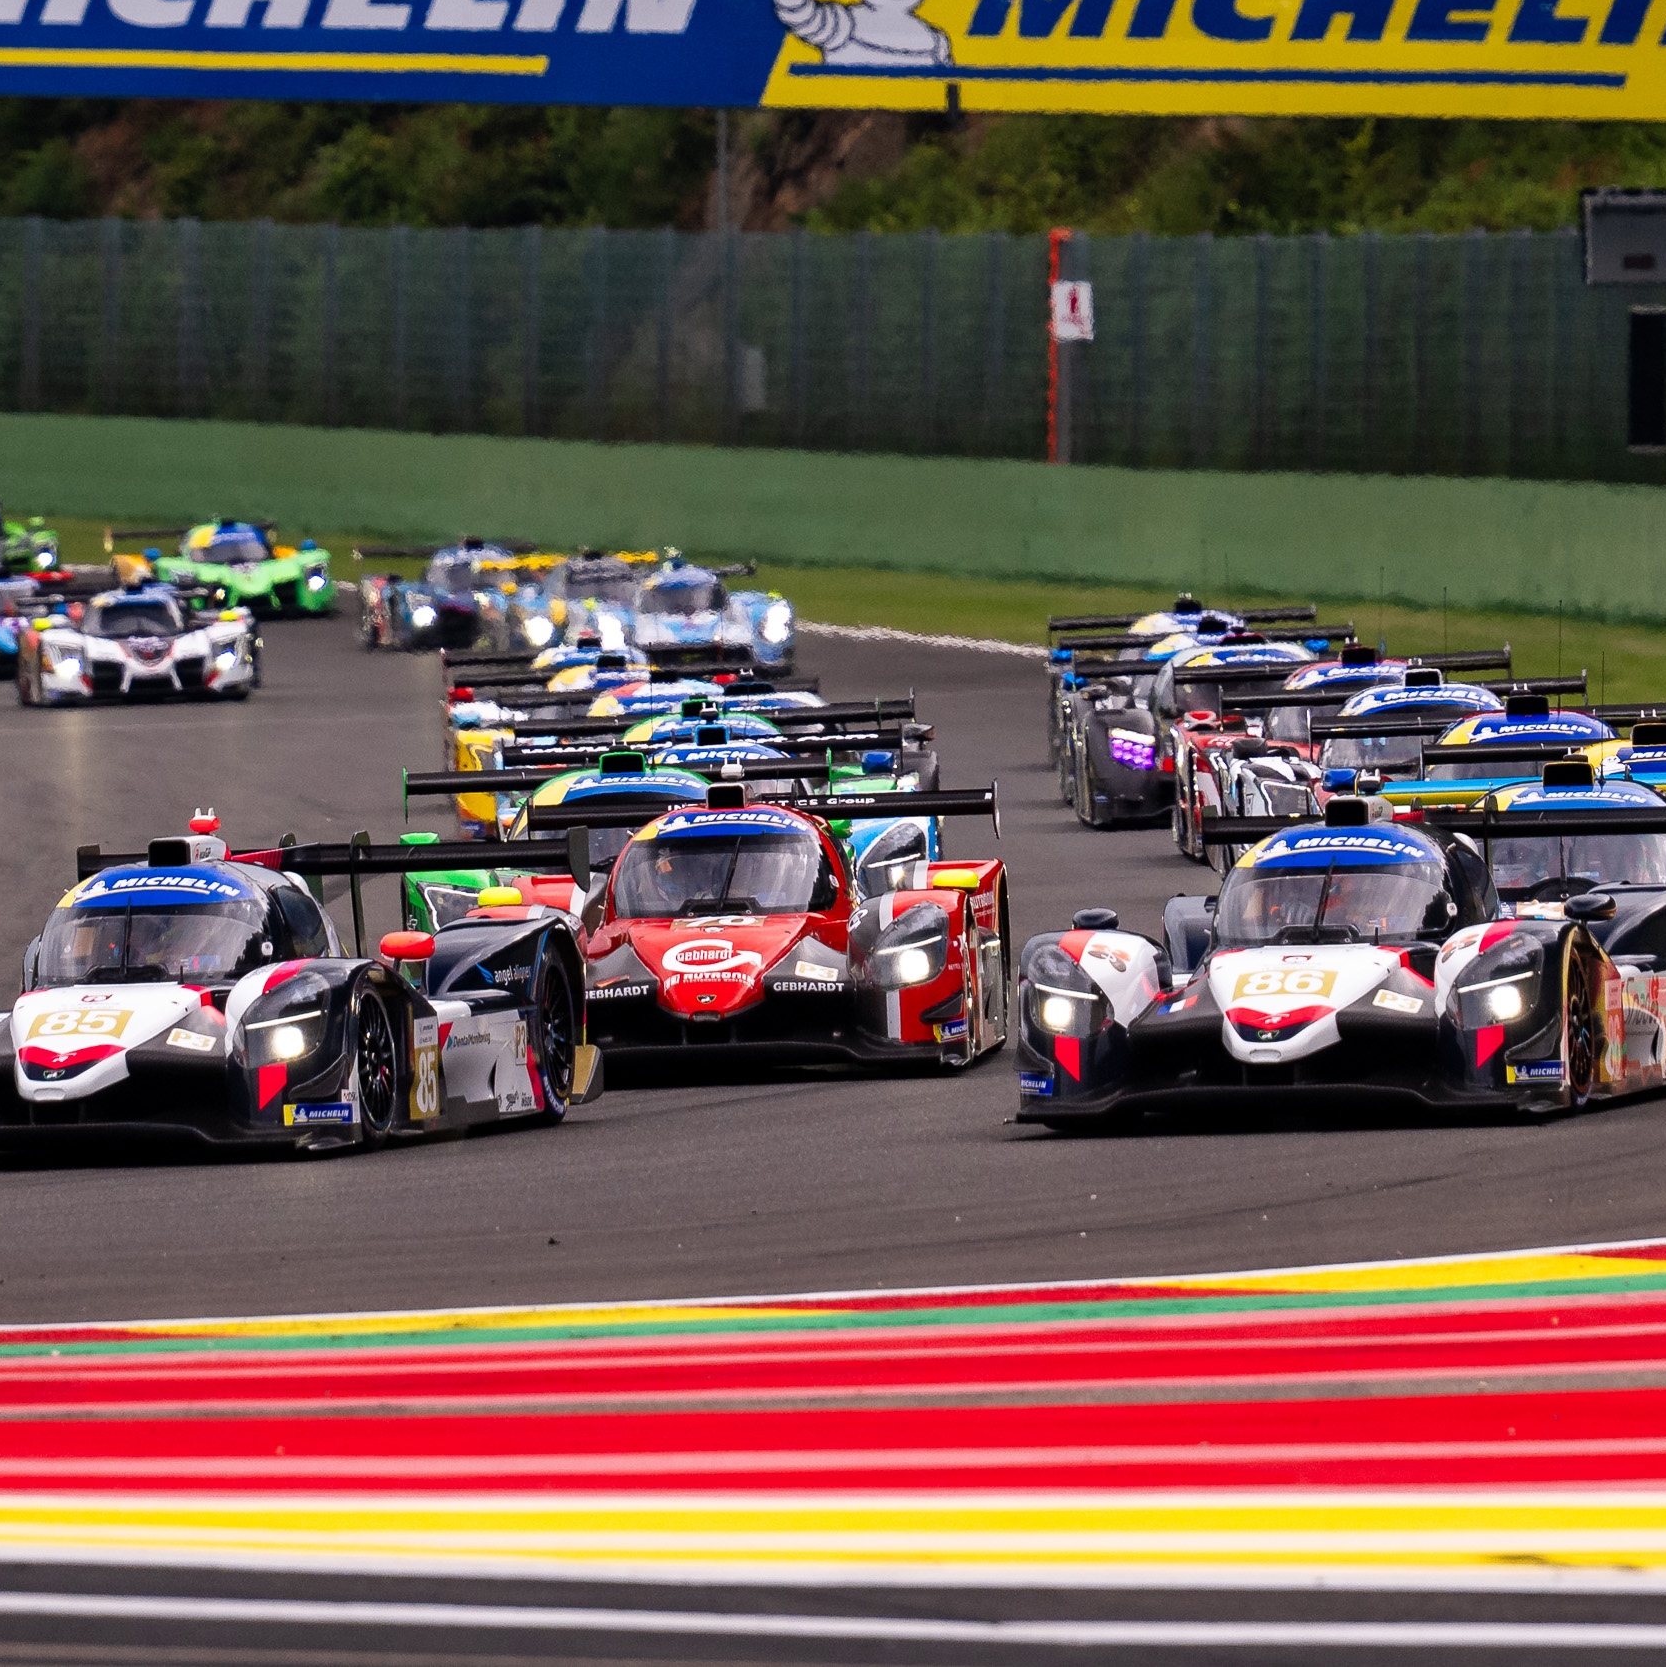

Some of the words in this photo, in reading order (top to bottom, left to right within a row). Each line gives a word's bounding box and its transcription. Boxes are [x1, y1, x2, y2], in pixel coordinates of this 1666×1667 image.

[1499, 723, 1593, 734] MICHELIN
[600, 776, 703, 788] MICHELIN
[826, 797, 876, 805] Group
[1545, 791, 1647, 804] MICHELIN
[693, 812, 809, 831] MICHELIN
[1294, 836, 1425, 858] MICHELIN
[113, 876, 241, 897] MICHELIN
[676, 948, 733, 962] gebhardt
[494, 965, 513, 986] angel
[798, 963, 835, 979] P3
[773, 981, 845, 992] GEBHARDT
[1242, 970, 1324, 994] 86
[1378, 991, 1418, 1010] P3
[38, 1010, 120, 1034] 85
[171, 1030, 212, 1048] P3
[516, 1025, 526, 1058] P3
[416, 1050, 437, 1113] 85
[309, 1109, 349, 1118] MICHELIN
